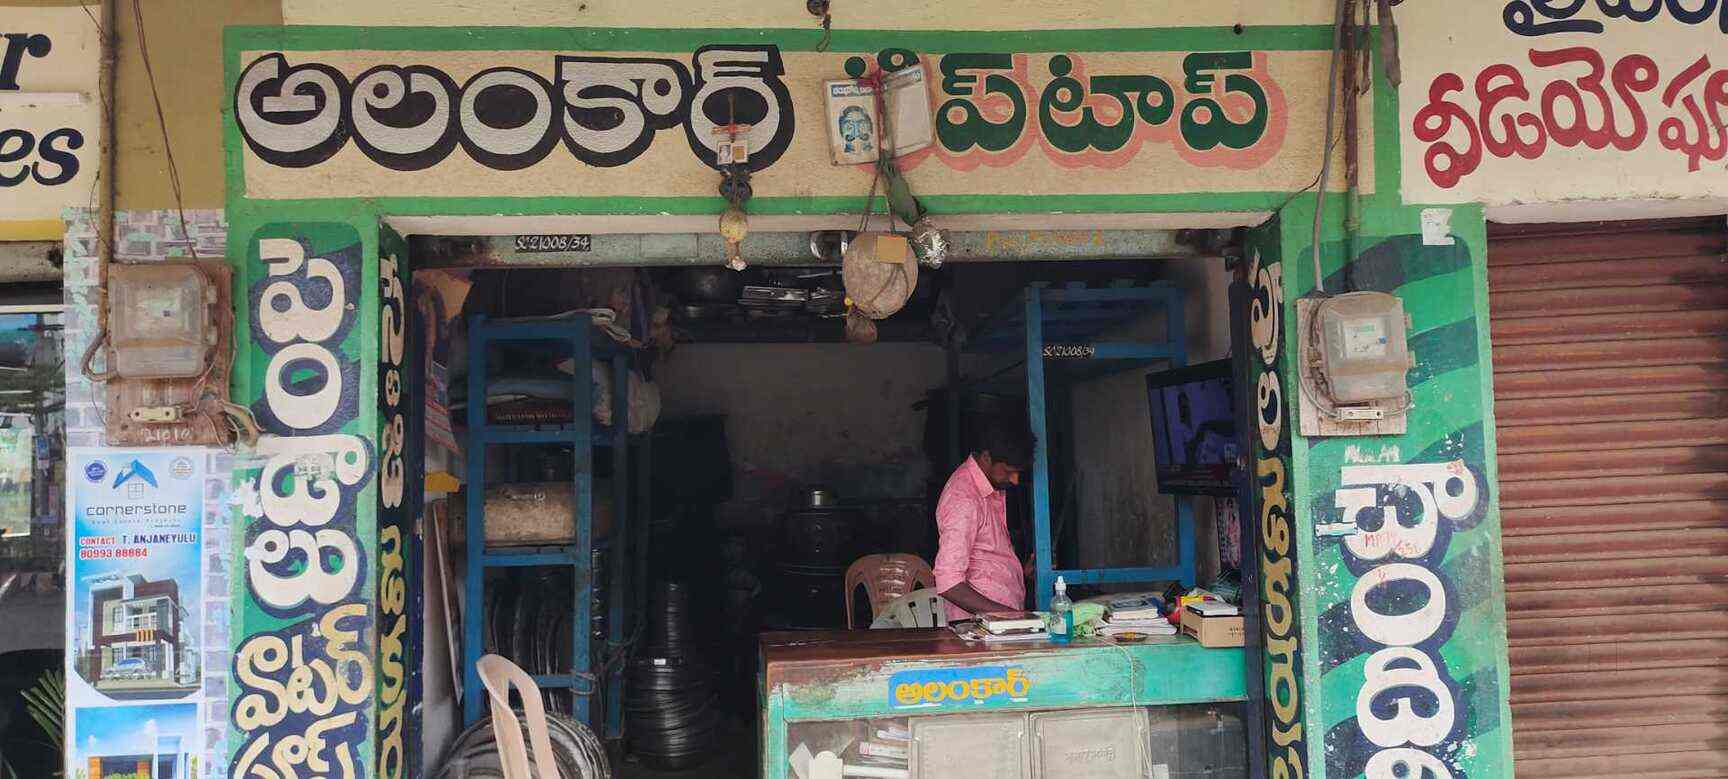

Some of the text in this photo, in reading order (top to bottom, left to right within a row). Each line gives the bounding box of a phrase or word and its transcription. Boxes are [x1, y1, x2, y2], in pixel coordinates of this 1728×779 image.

[234, 44, 795, 172] అలంకార్
[1413, 47, 1659, 188] వీడియో
[86, 503, 187, 516] cornerstone
[133, 532, 196, 545] ANJANEYULU
[235, 604, 373, 731] వాటర్
[895, 667, 1030, 704] అలంకార్
